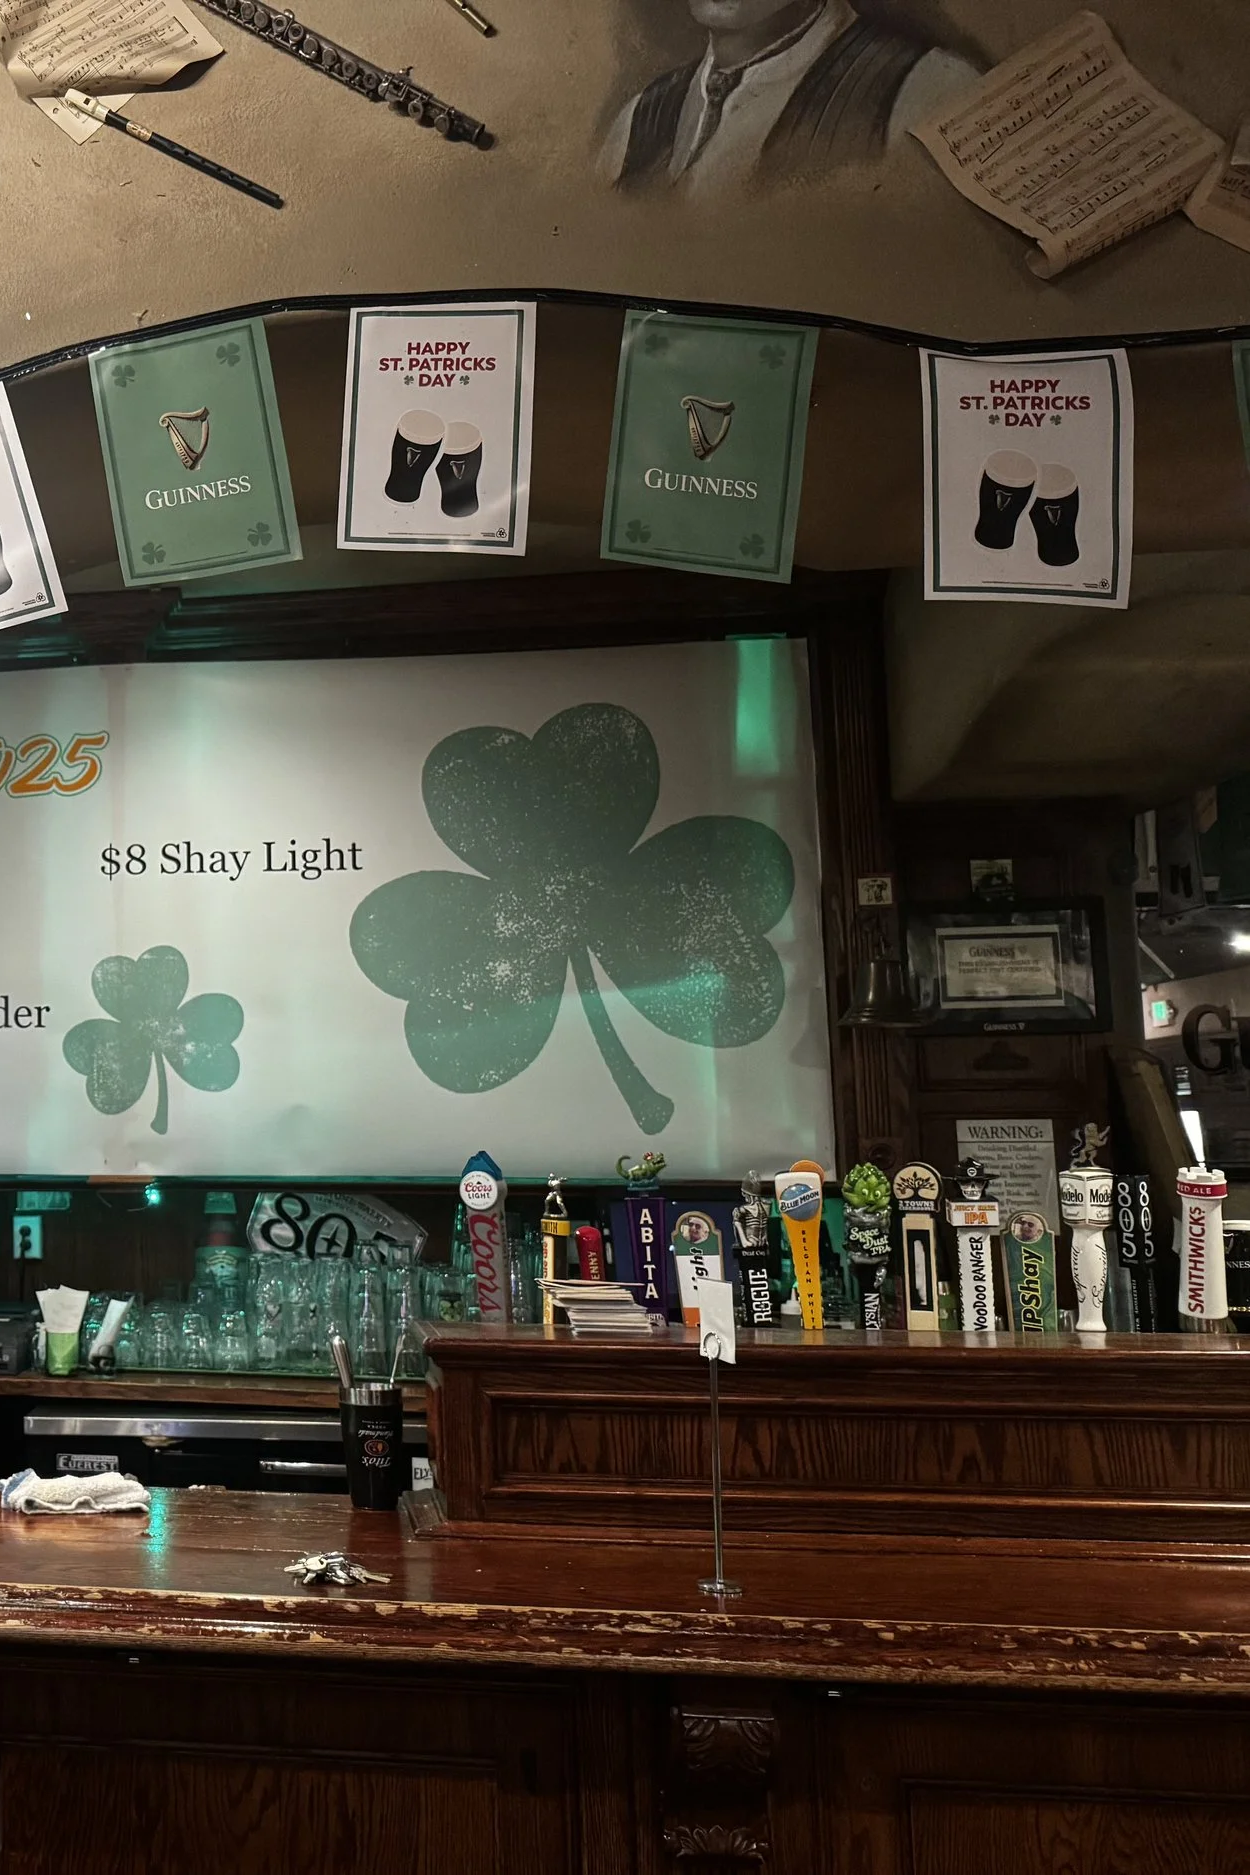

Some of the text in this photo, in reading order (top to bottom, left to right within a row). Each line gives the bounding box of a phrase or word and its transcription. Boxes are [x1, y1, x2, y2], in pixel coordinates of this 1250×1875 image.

[407, 341, 470, 356] HAPPY
[378, 357, 496, 372] ST. PATRICKS
[418, 373, 455, 387] DAY
[989, 379, 1060, 394] HAPPY
[959, 395, 1091, 411] ST. PATRICKS
[1004, 412, 1046, 428] DAY
[644, 467, 758, 500] GUINNESS
[144, 475, 252, 511] GUINNESS
[100, 838, 363, 881] $8 Shay Light
[968, 1126, 1043, 1139] WARNING:
[464, 1182, 492, 1193] Coors
[1193, 1187, 1212, 1195] ALE
[780, 1190, 820, 1212] BLUE MOON
[1090, 1189, 1111, 1203] Mode
[964, 1212, 988, 1225] IPA
[1117, 1182, 1137, 1258] 805
[1139, 1181, 1155, 1258] 805
[850, 1227, 879, 1242] Space
[863, 1235, 889, 1250] Dust
[639, 1208, 659, 1299] ABITA
[802, 1230, 812, 1284] BELGIAN
[469, 1213, 502, 1314] Coors
[969, 1236, 988, 1331] VOODOO RANGER
[748, 1268, 772, 1323] ROGUE
[864, 1292, 881, 1331] LYSIAN
